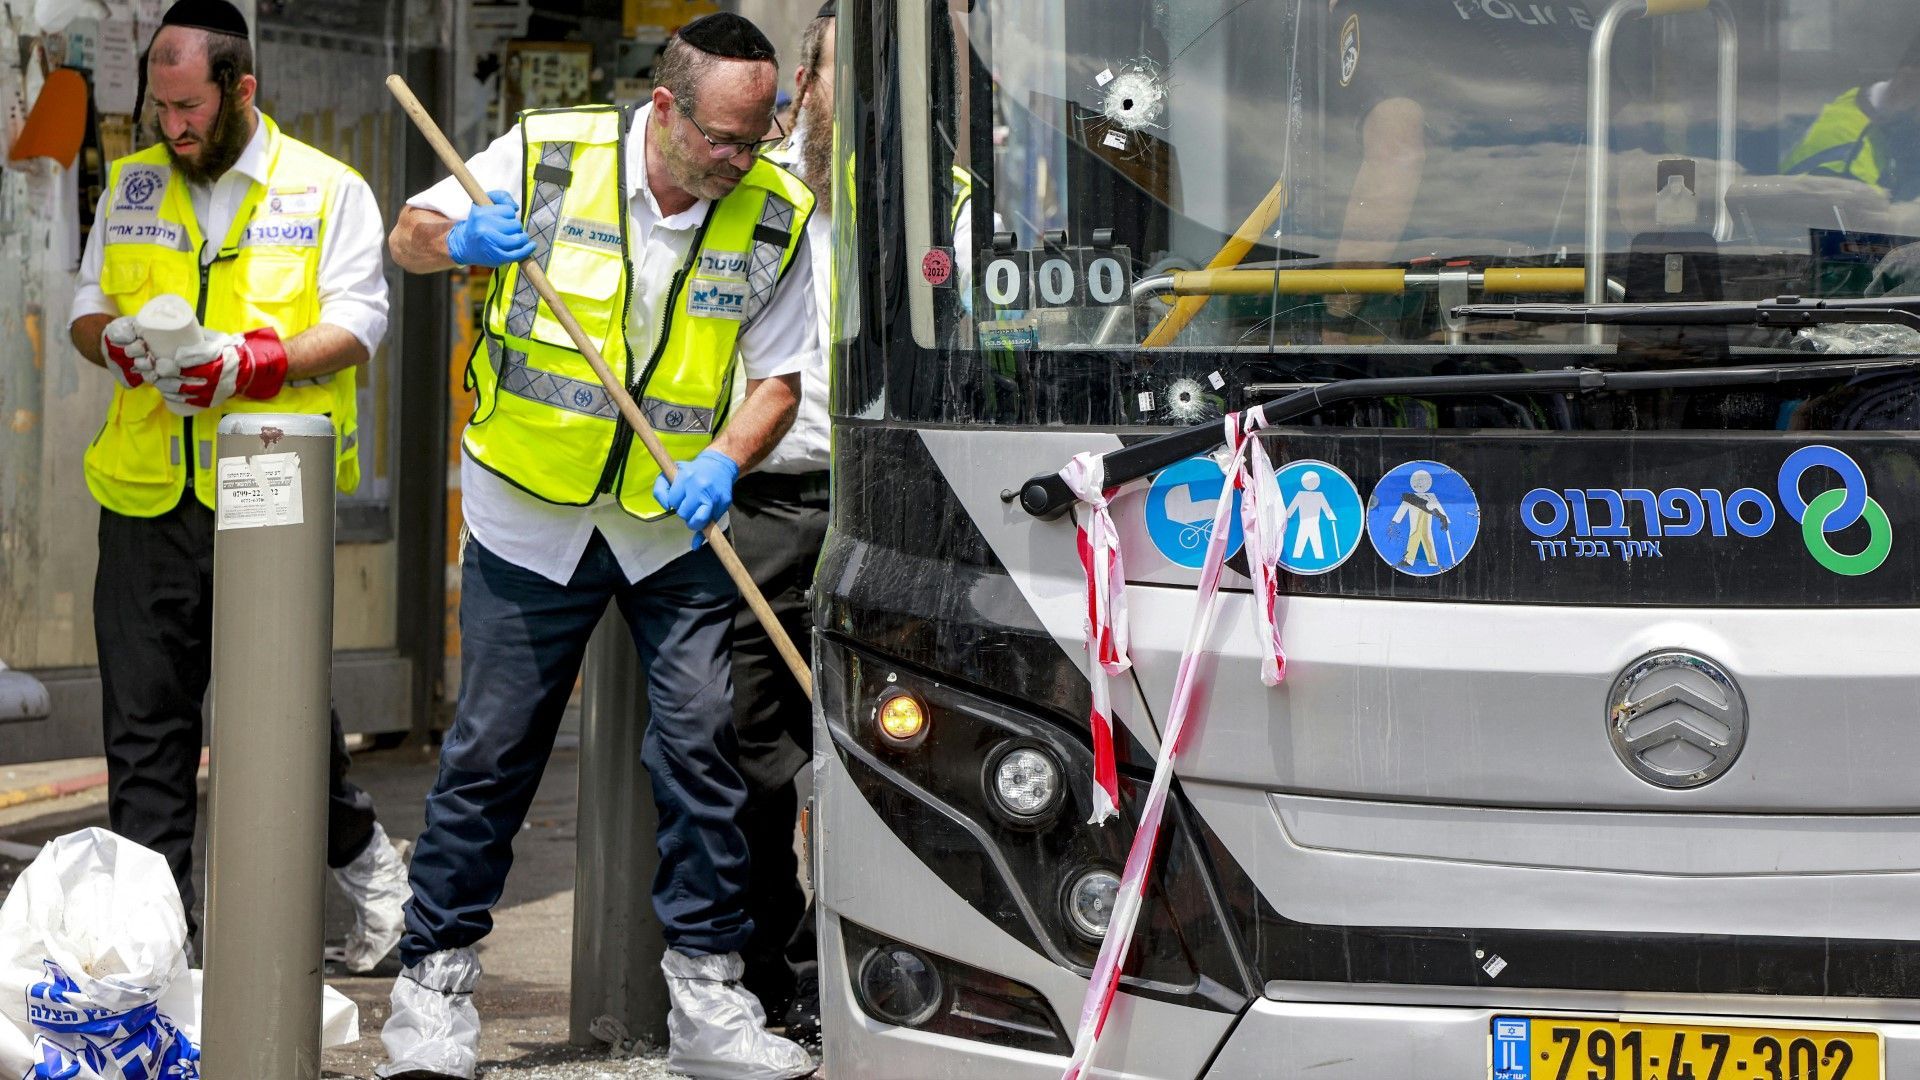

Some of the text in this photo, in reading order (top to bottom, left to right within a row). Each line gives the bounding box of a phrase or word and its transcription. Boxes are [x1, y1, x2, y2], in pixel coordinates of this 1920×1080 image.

[136, 225, 176, 241] מתנדב
[927, 267, 945, 277] 2022
[1520, 488, 1775, 538] סופרבוס
[1530, 537, 1663, 561] איתך בכל דרך
[31, 1004, 79, 1021] הצלה
[1502, 1041, 1524, 1070] IL
[1495, 1071, 1527, 1080] ישראל
